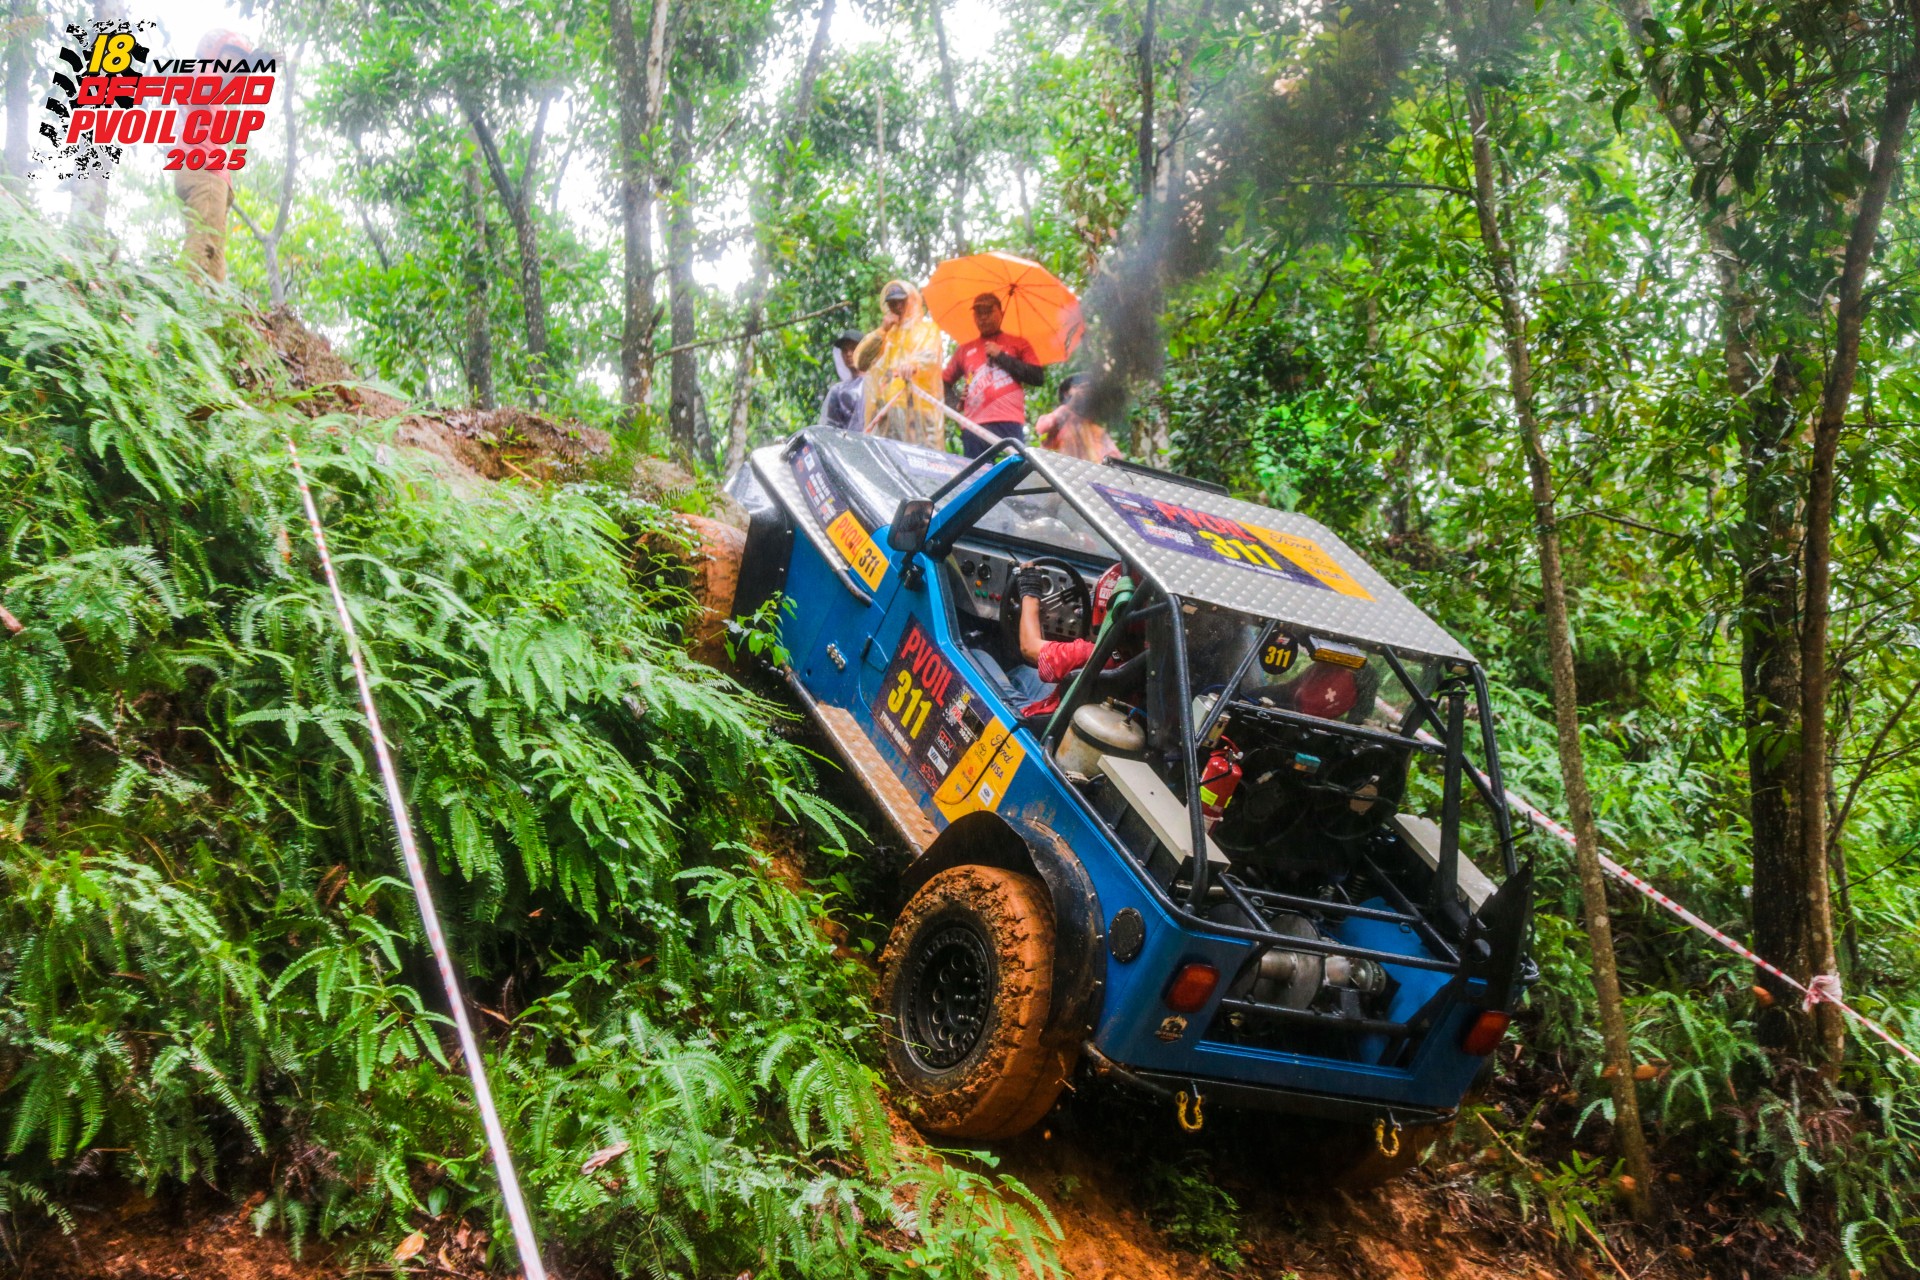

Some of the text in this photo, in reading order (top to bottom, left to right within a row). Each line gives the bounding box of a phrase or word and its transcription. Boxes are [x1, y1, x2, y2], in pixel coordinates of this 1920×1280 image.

[1152, 499, 1258, 542] PVOIL
[835, 517, 880, 578] PVOIL 311
[1198, 530, 1283, 571] 311
[901, 627, 953, 708] PVOIL
[1264, 645, 1291, 668] 311
[887, 669, 933, 740] 311
